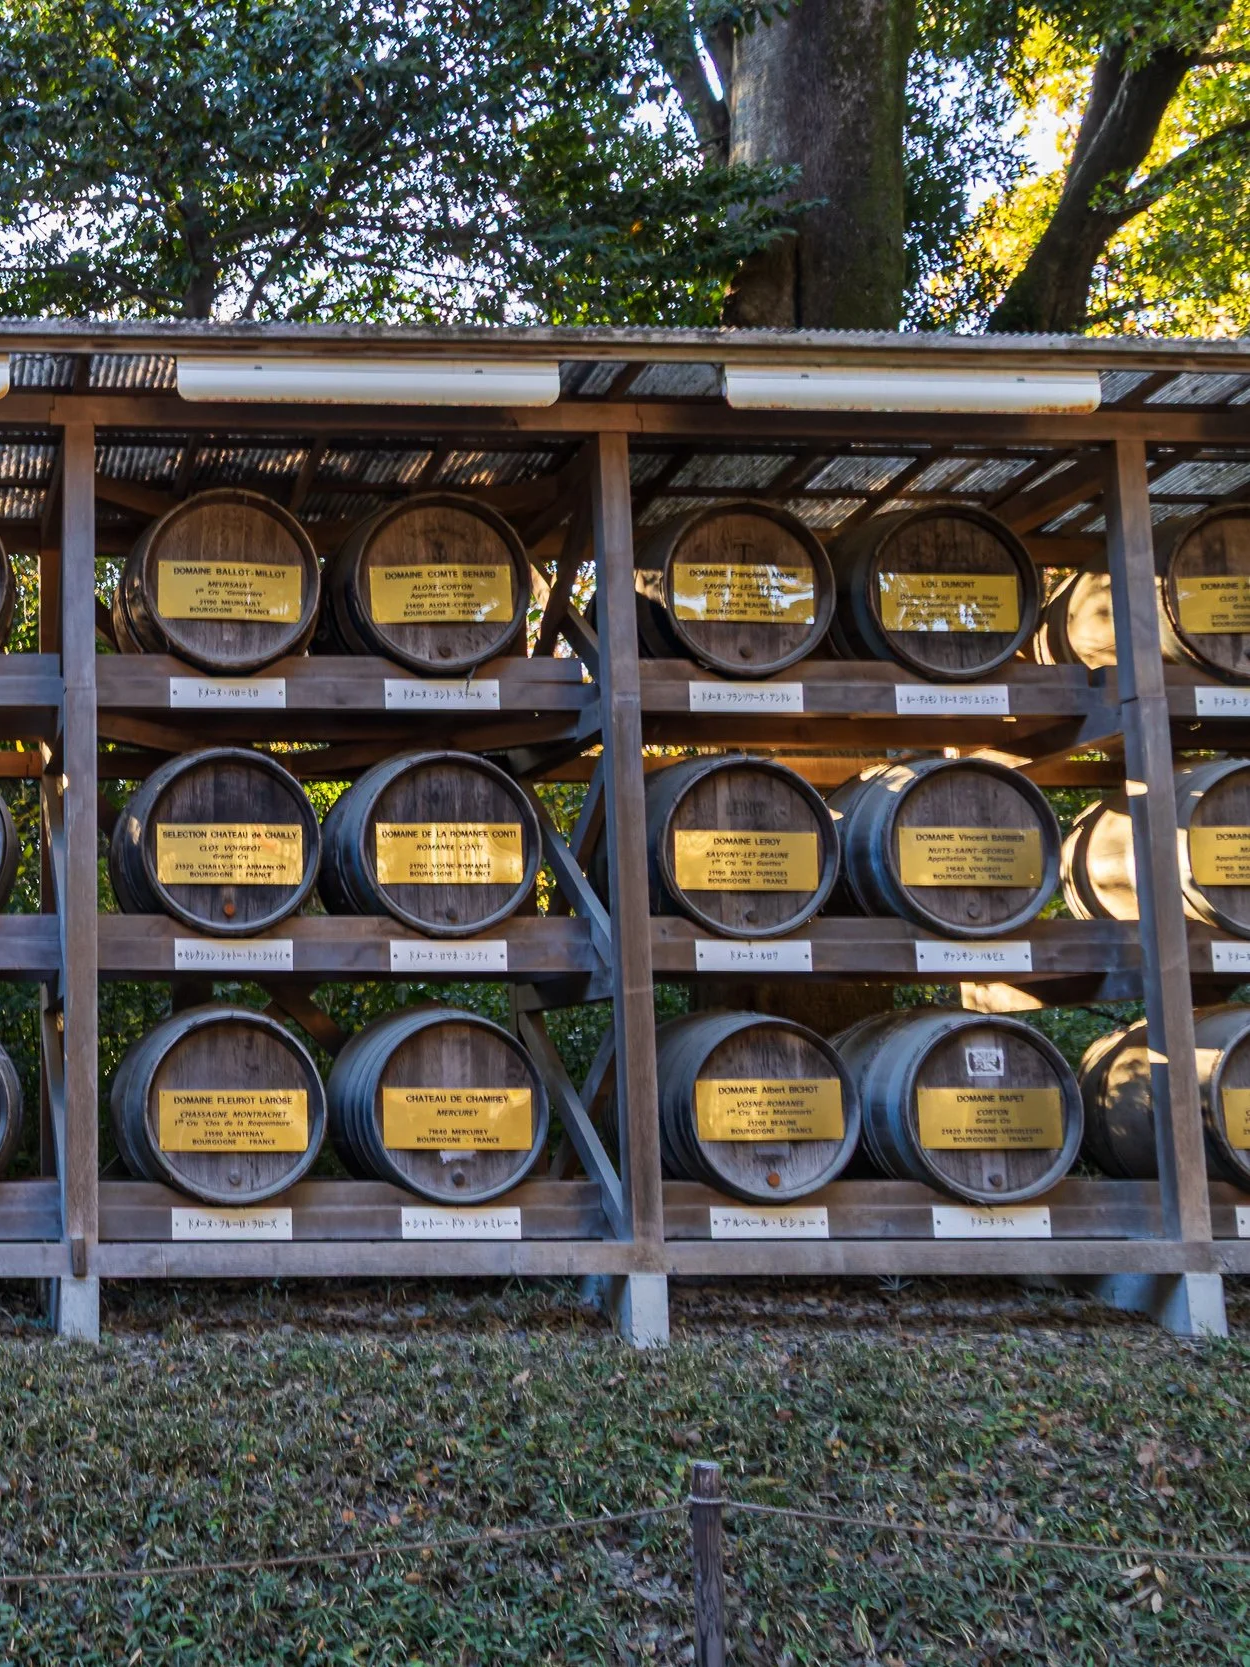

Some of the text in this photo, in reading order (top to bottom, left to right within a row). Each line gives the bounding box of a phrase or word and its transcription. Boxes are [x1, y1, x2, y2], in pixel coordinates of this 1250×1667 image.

[173, 566, 211, 576] DOMAINE
[384, 570, 458, 580] DOMAINE COMTE
[689, 569, 727, 578] DOMAINE
[921, 581, 975, 589] LOU DUMONT
[210, 830, 248, 839] CHATEAU
[382, 830, 418, 838] DOMAINE
[421, 830, 432, 838] DE
[436, 830, 447, 838] LA
[492, 830, 517, 838] CONTI
[916, 834, 955, 842] DOMAINE
[958, 834, 988, 842] Vincent
[713, 837, 781, 846] DOMAINE LEROY
[718, 1086, 757, 1095] DOMAINE
[761, 1086, 785, 1094] Albert
[173, 1096, 213, 1105] DOMAINE
[217, 1096, 256, 1105] FLEUROT
[405, 1095, 509, 1104] CHATEAU DE CHAMIREY
[957, 1095, 995, 1103] DOMAINE
[436, 1109, 479, 1117] MERCUREY
[416, 1136, 500, 1144] BOURGOGNE FRANCE
